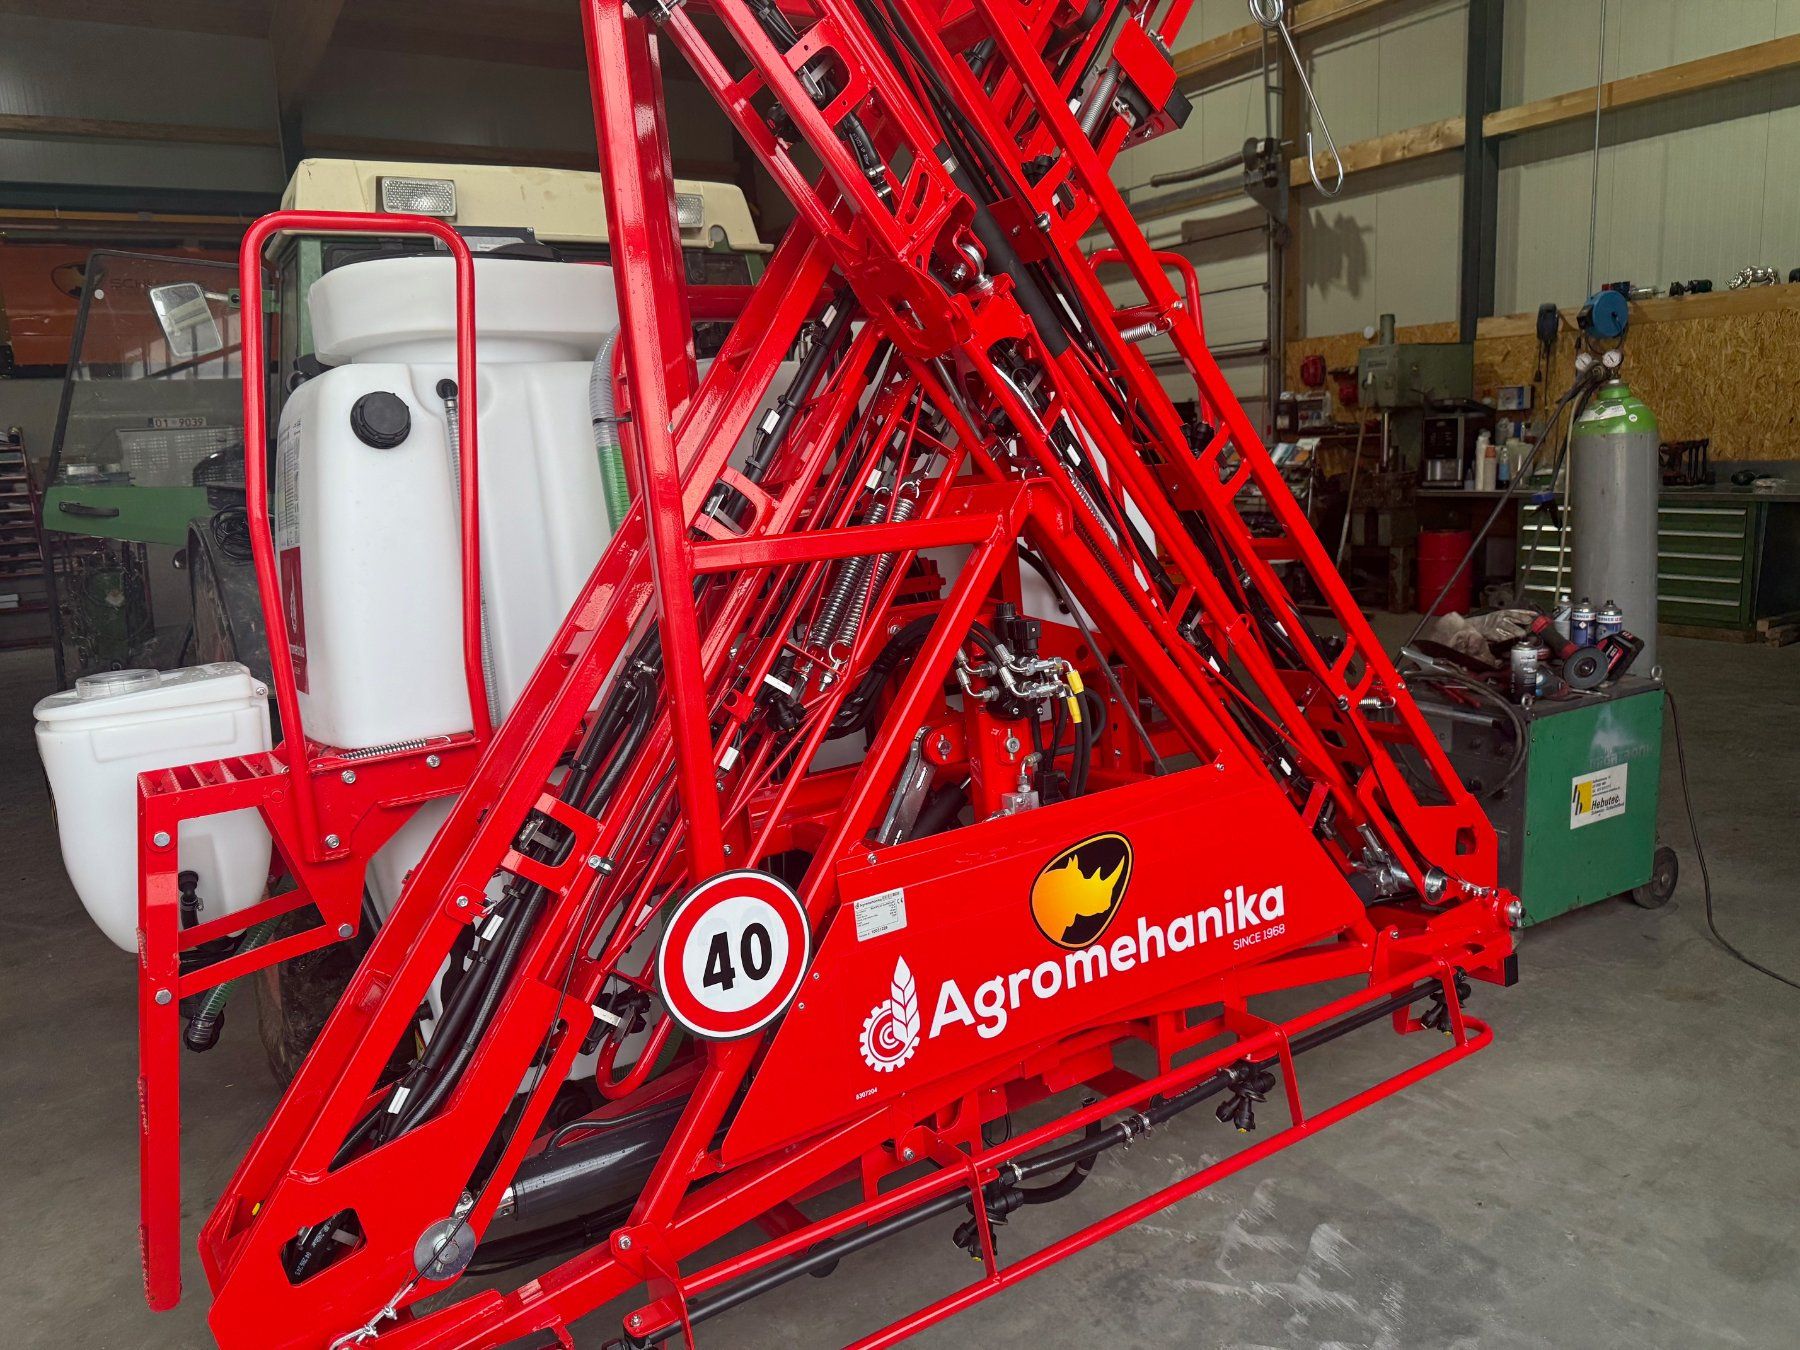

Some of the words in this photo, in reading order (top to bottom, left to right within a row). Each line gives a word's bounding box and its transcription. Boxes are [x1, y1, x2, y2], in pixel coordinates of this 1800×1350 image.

[703, 922, 772, 991] 40
[929, 885, 1285, 1039] Agromehanika
[1233, 931, 1261, 951] SINCE
[1263, 923, 1285, 940] 1968
